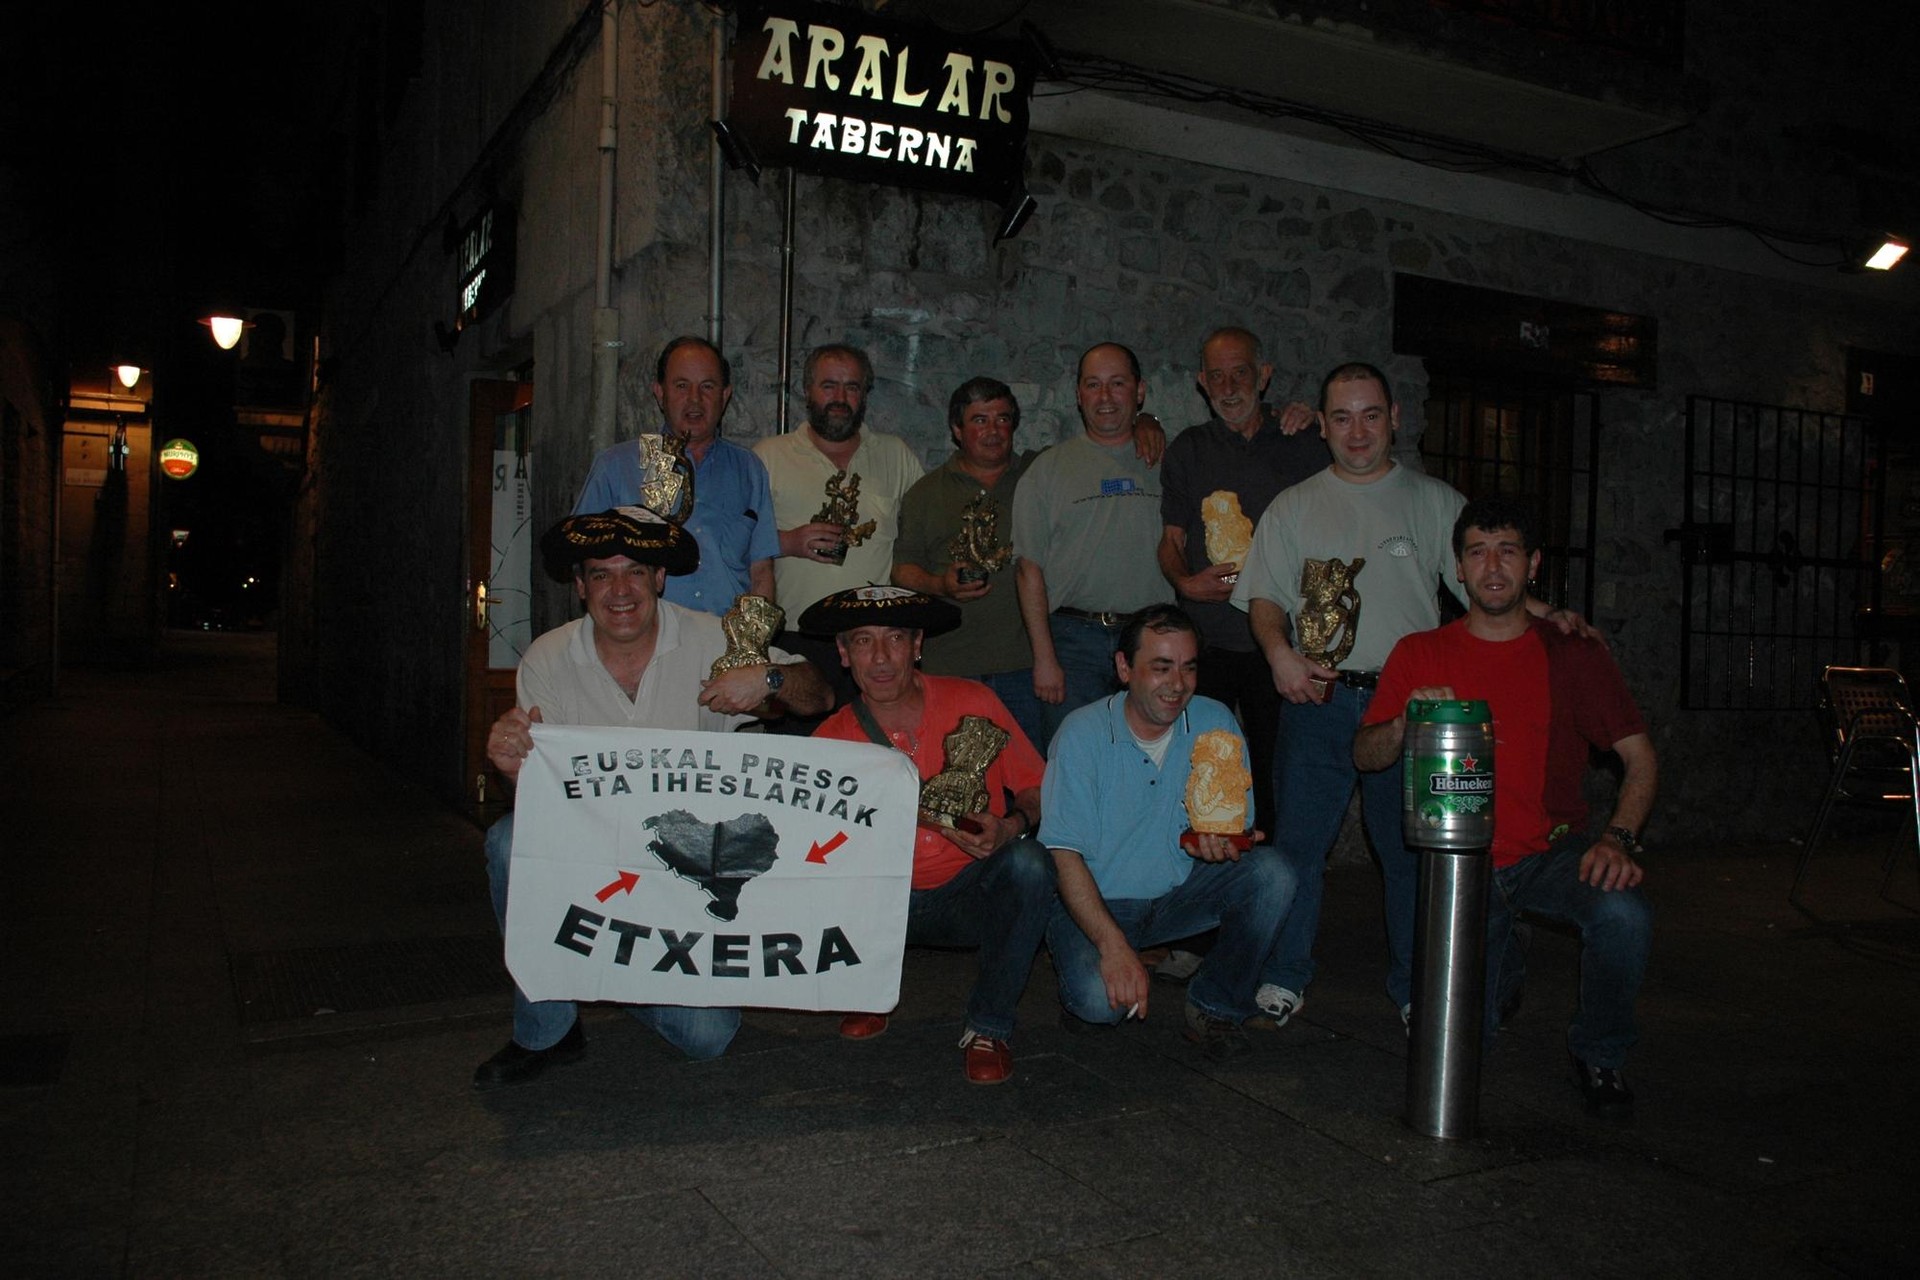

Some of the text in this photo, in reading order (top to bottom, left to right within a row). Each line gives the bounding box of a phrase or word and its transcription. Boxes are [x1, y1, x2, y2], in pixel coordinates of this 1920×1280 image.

[755, 15, 1016, 124] ARALAR
[784, 106, 979, 173] TABERNA
[563, 772, 879, 828] ETA IHESLARIAK
[571, 748, 860, 796] EUSKAL PRESO
[554, 904, 862, 978] ETXERA
